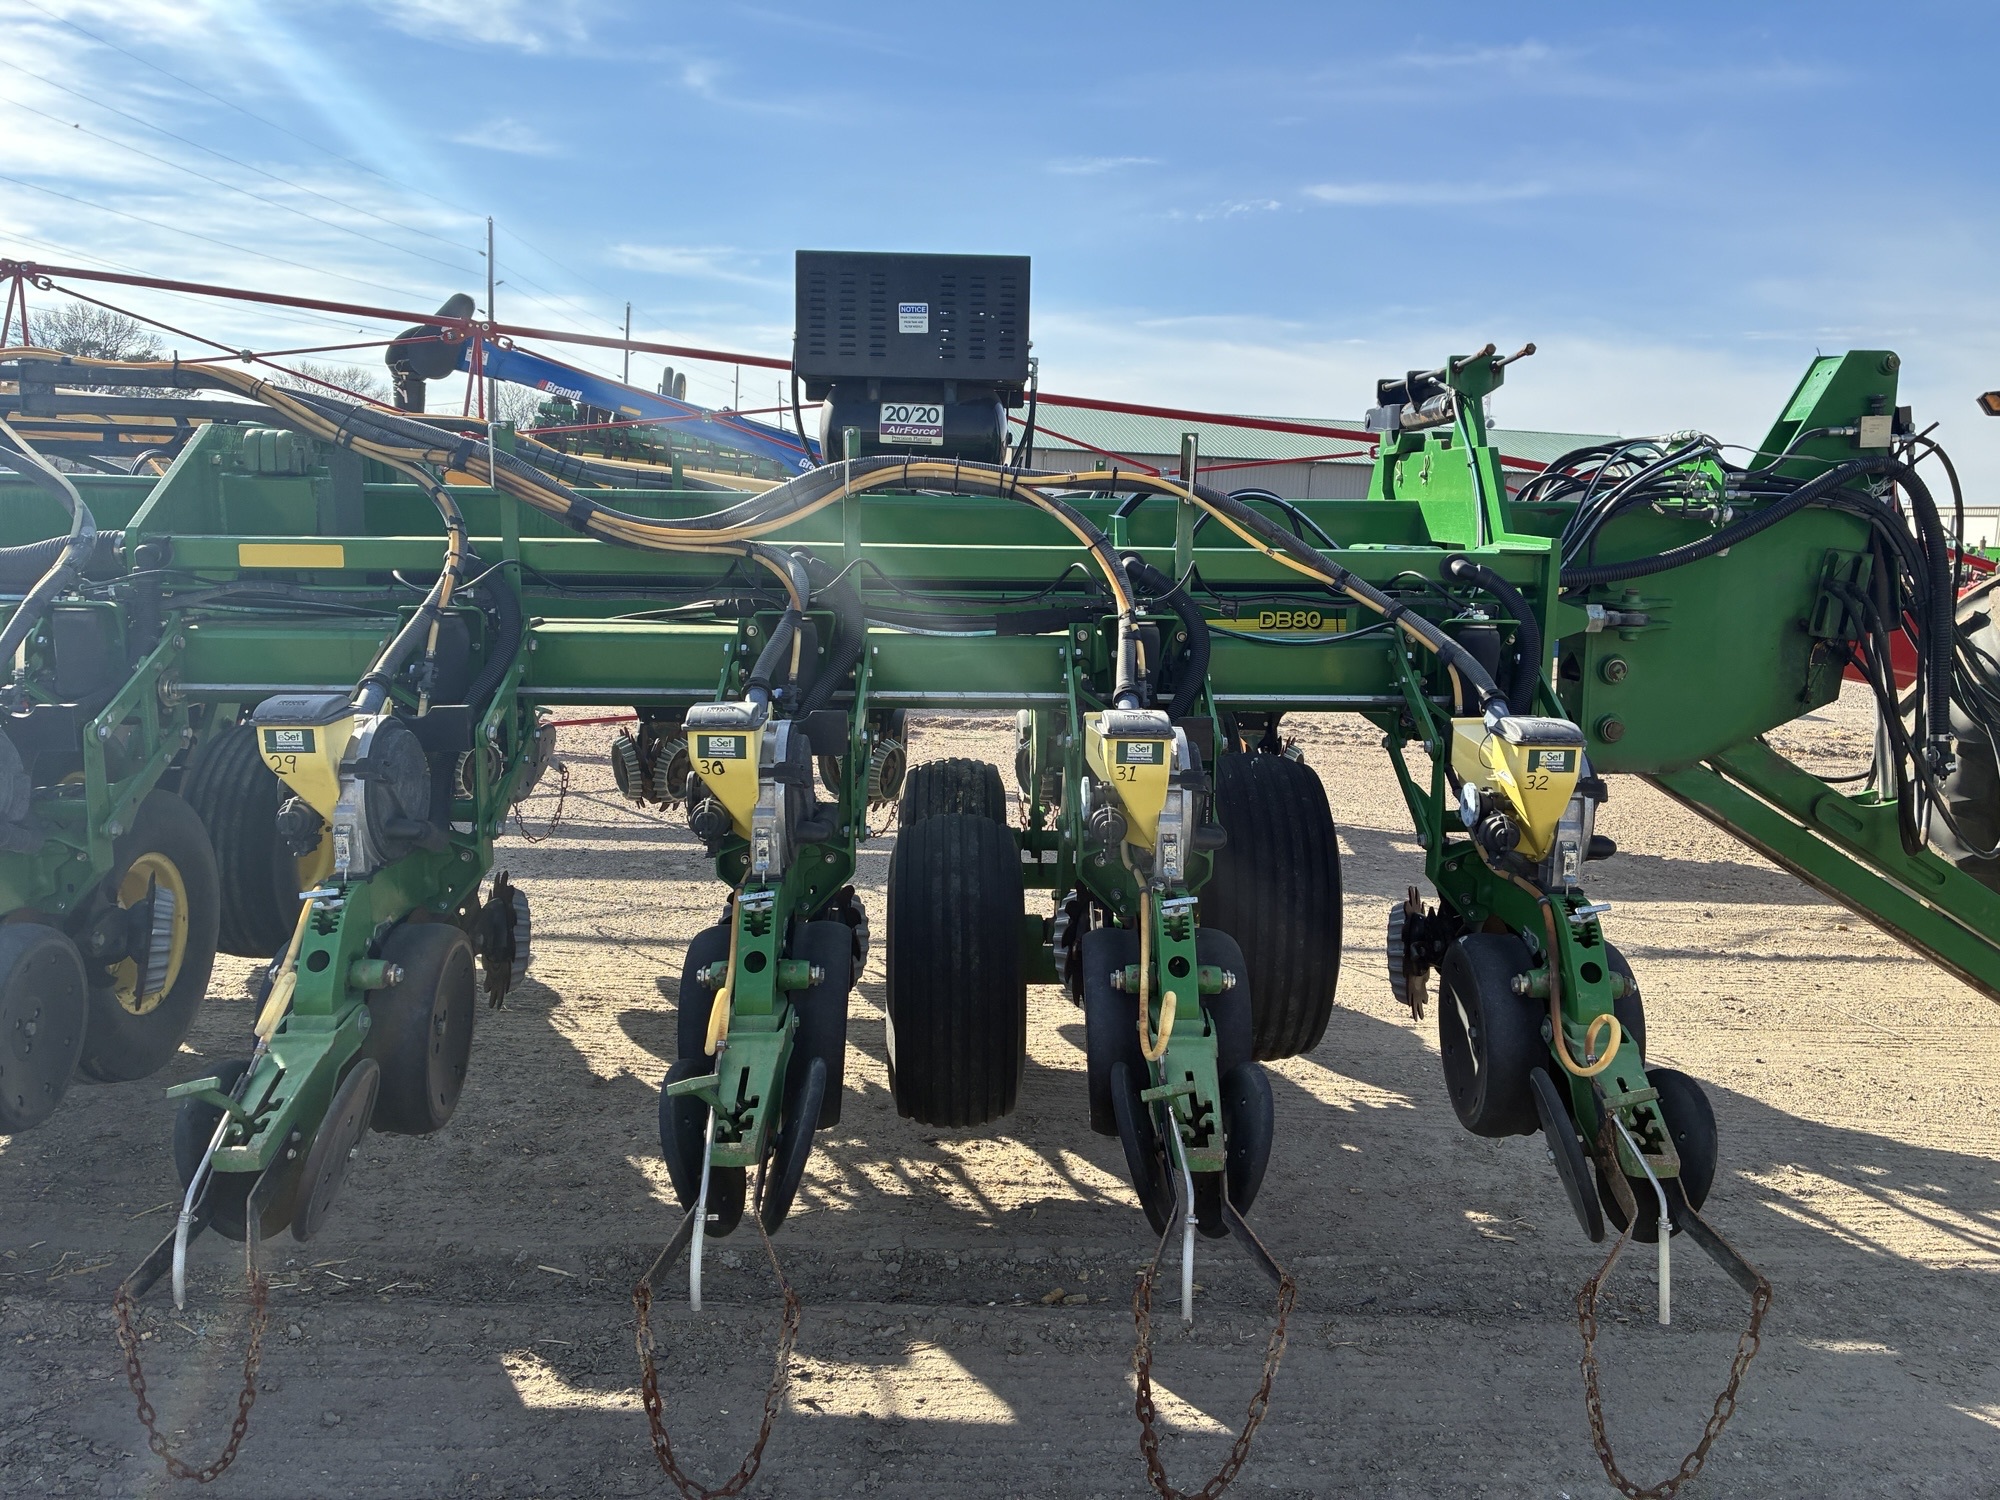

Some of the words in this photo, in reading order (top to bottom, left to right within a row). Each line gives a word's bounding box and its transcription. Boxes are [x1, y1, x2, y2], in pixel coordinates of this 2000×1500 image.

[544, 381, 583, 400] Brandt
[884, 405, 940, 424] 20/20
[886, 425, 938, 436] AirForce
[1259, 611, 1322, 629] DB80
[277, 731, 300, 741] eSet
[710, 738, 732, 747] eSet
[1129, 743, 1150, 753] eSet
[269, 754, 297, 775] 29
[699, 759, 726, 776] 30
[1115, 765, 1137, 782] 31
[1524, 774, 1549, 791] 32
